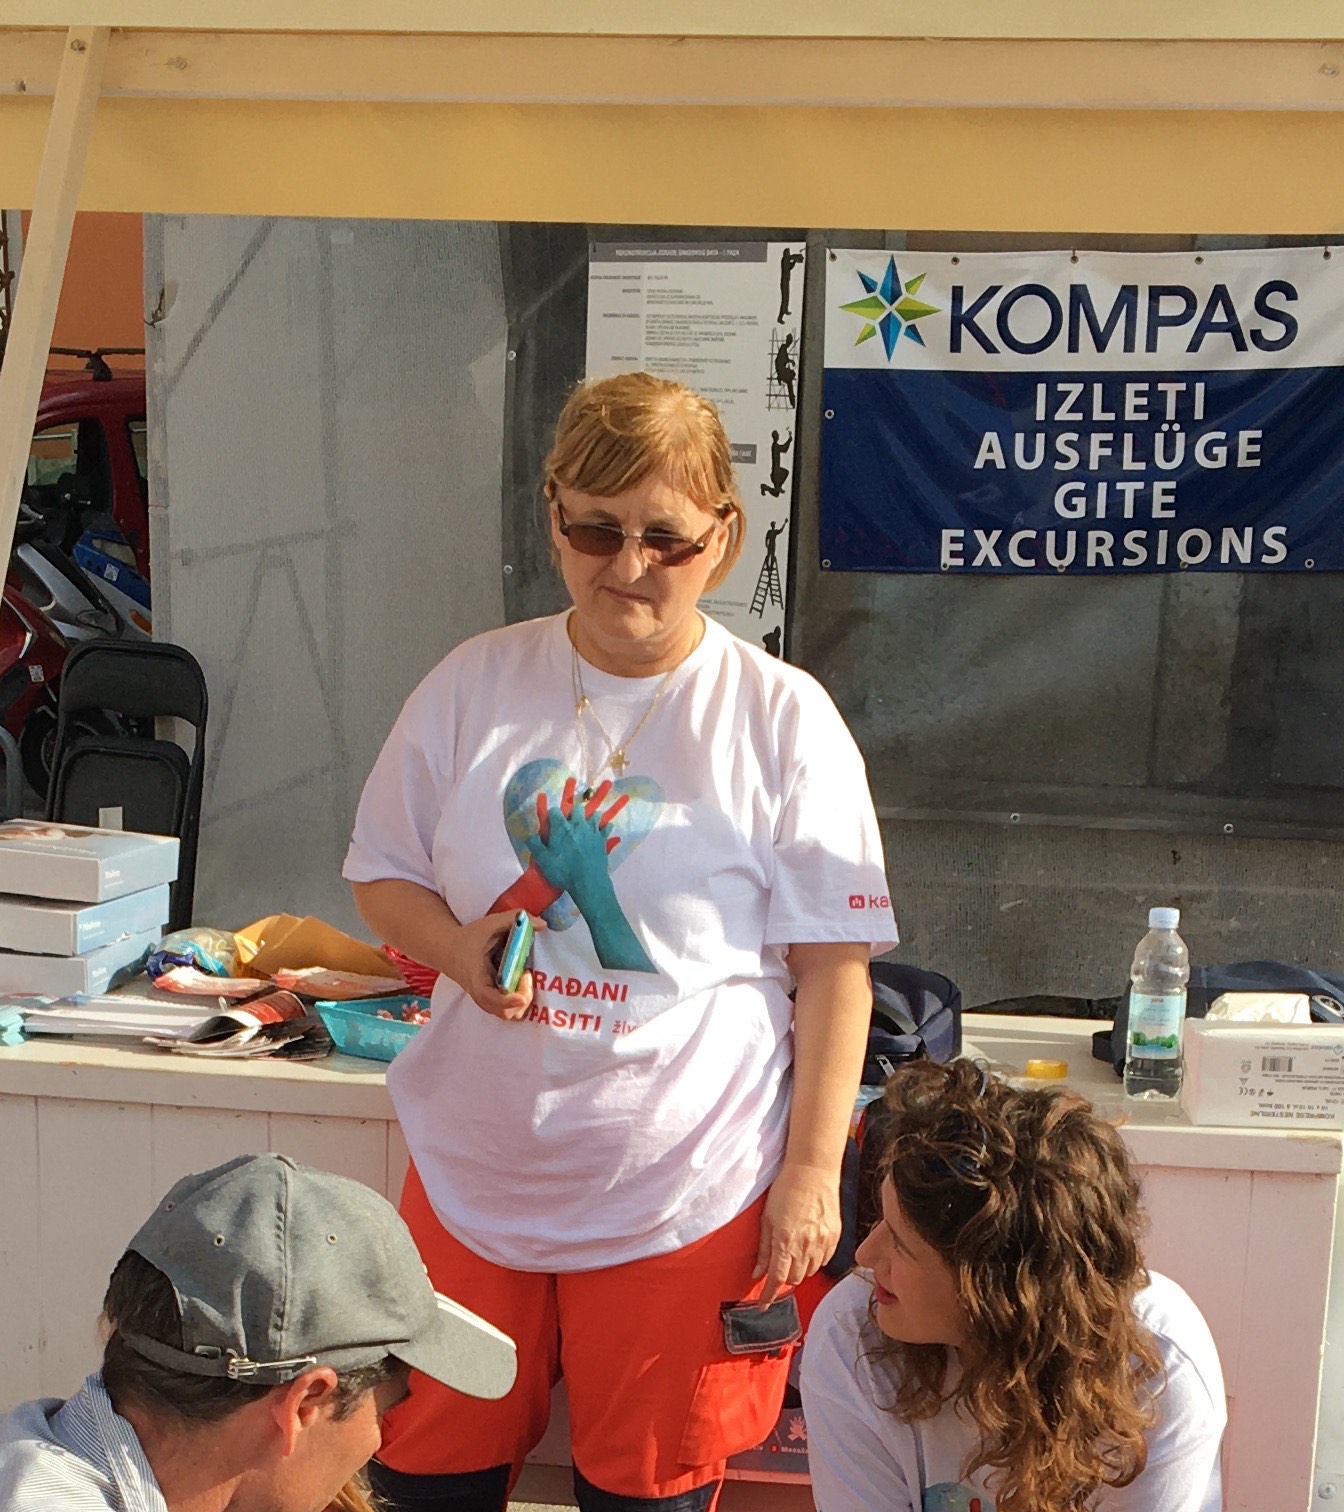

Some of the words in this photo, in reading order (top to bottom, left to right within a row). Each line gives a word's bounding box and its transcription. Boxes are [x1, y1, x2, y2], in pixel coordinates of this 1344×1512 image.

[949, 279, 1299, 355] KOMPAS
[1035, 382, 1205, 423] IZLETI
[973, 423, 1264, 471] AUSFLÜGE
[1053, 480, 1178, 519] GITE
[939, 525, 1289, 568] EXCURSIONS
[532, 970, 629, 1003] RAĐANI
[528, 1003, 602, 1032] PASITI
